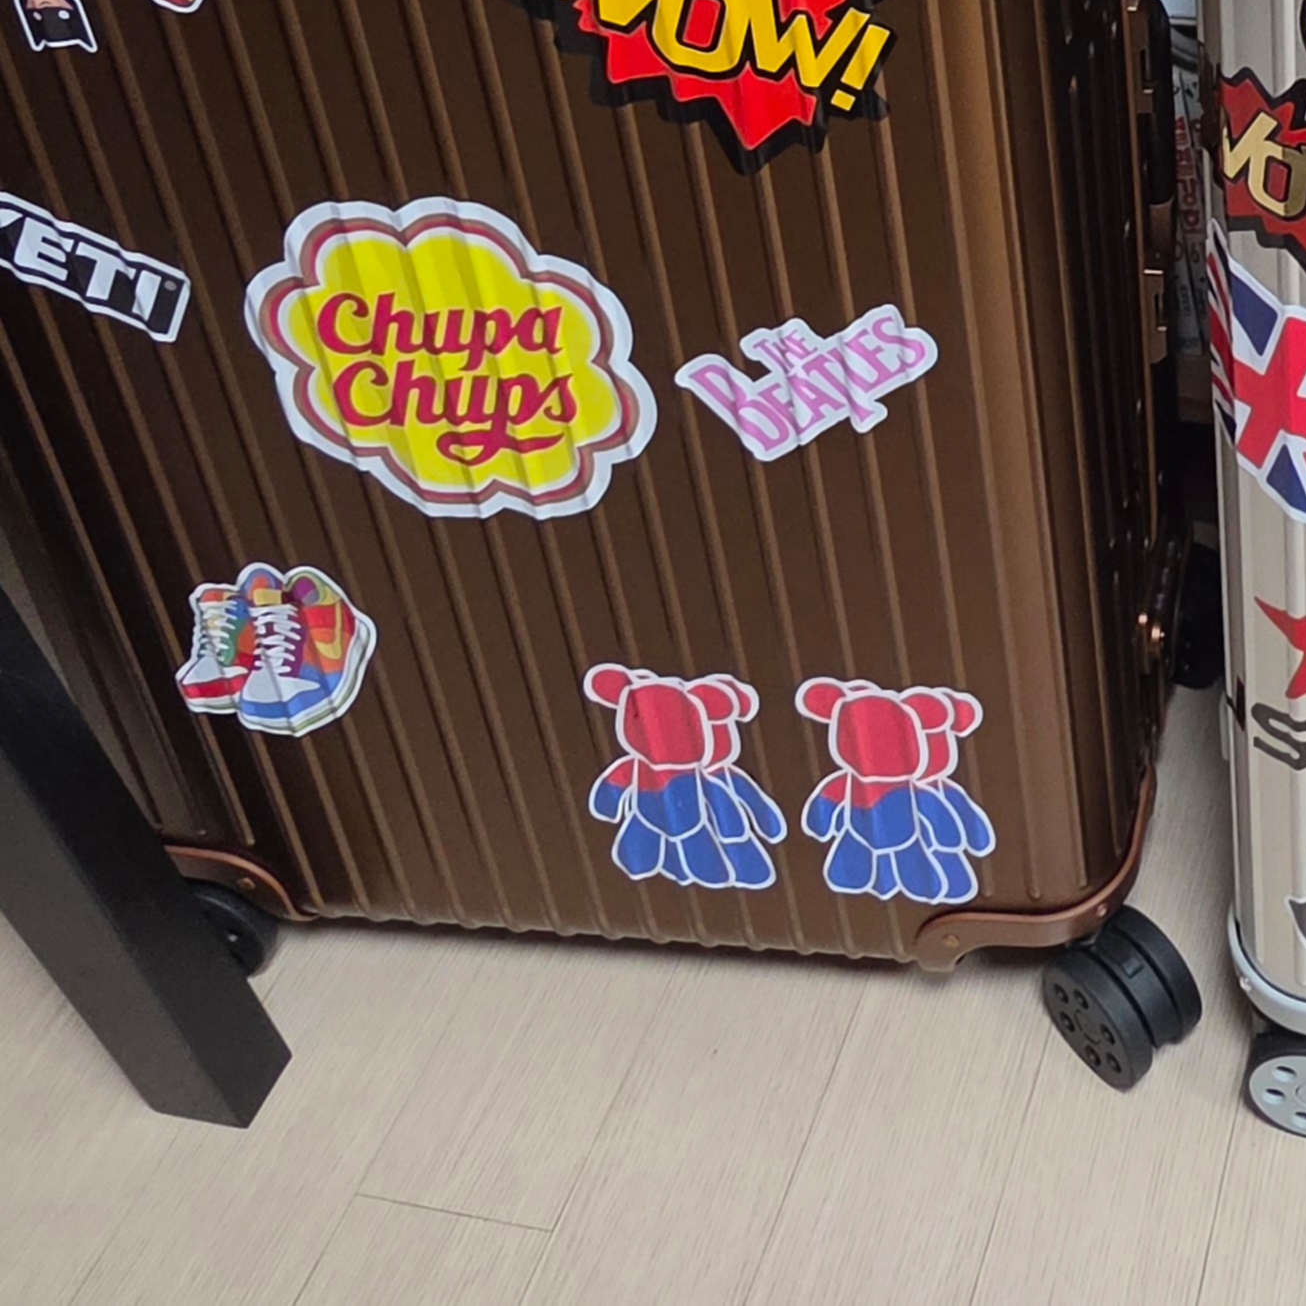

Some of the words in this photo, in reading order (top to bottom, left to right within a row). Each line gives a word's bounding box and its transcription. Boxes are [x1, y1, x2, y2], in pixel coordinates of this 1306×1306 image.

[316, 291, 565, 373] Chupa
[752, 327, 820, 377] THE
[332, 358, 578, 466] Chups
[690, 315, 929, 452] BEATLES
